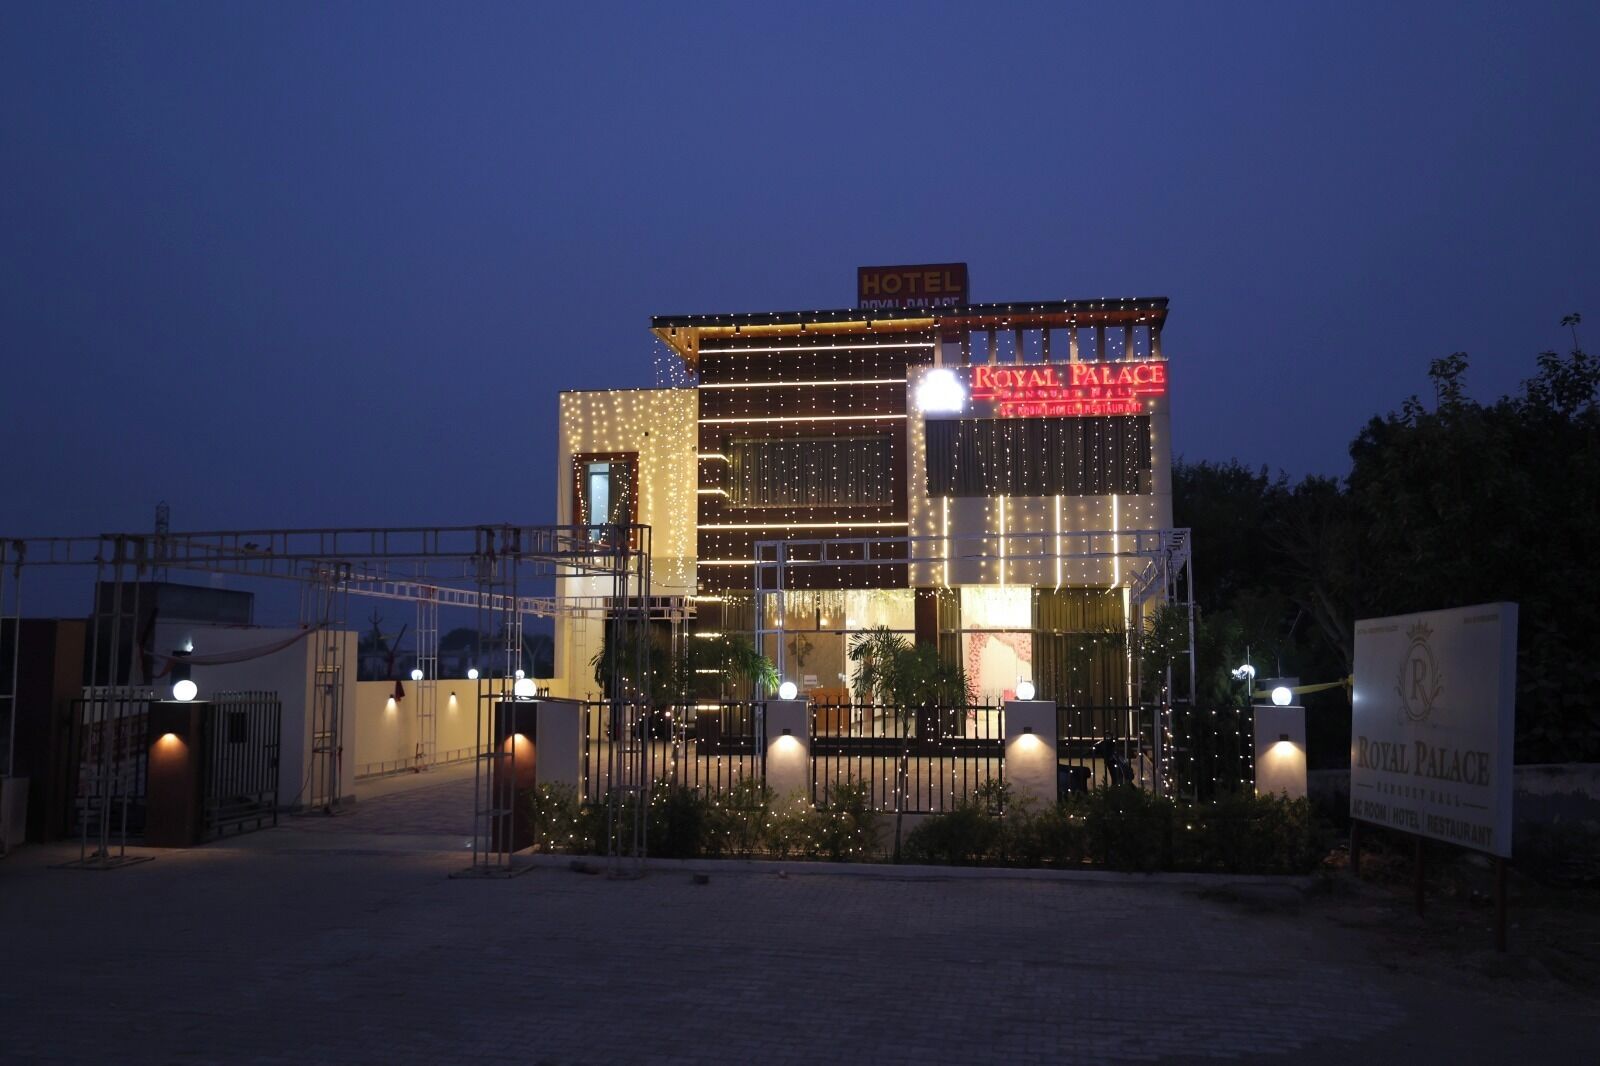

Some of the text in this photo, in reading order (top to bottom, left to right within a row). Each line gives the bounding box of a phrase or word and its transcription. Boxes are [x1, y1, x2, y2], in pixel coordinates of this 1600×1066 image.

[862, 271, 961, 295] HOTEL
[973, 363, 1165, 388] ROYAL PALACE
[1002, 387, 1133, 399] BANQUET HALL
[1018, 405, 1043, 415] ROOM
[1049, 405, 1077, 415] HOTEL
[1085, 403, 1143, 415] RESTAURANT
[1357, 735, 1490, 787] ROYAL PALACE
[1352, 799, 1493, 846] AC ROOM HOTEL RESTAURANT
